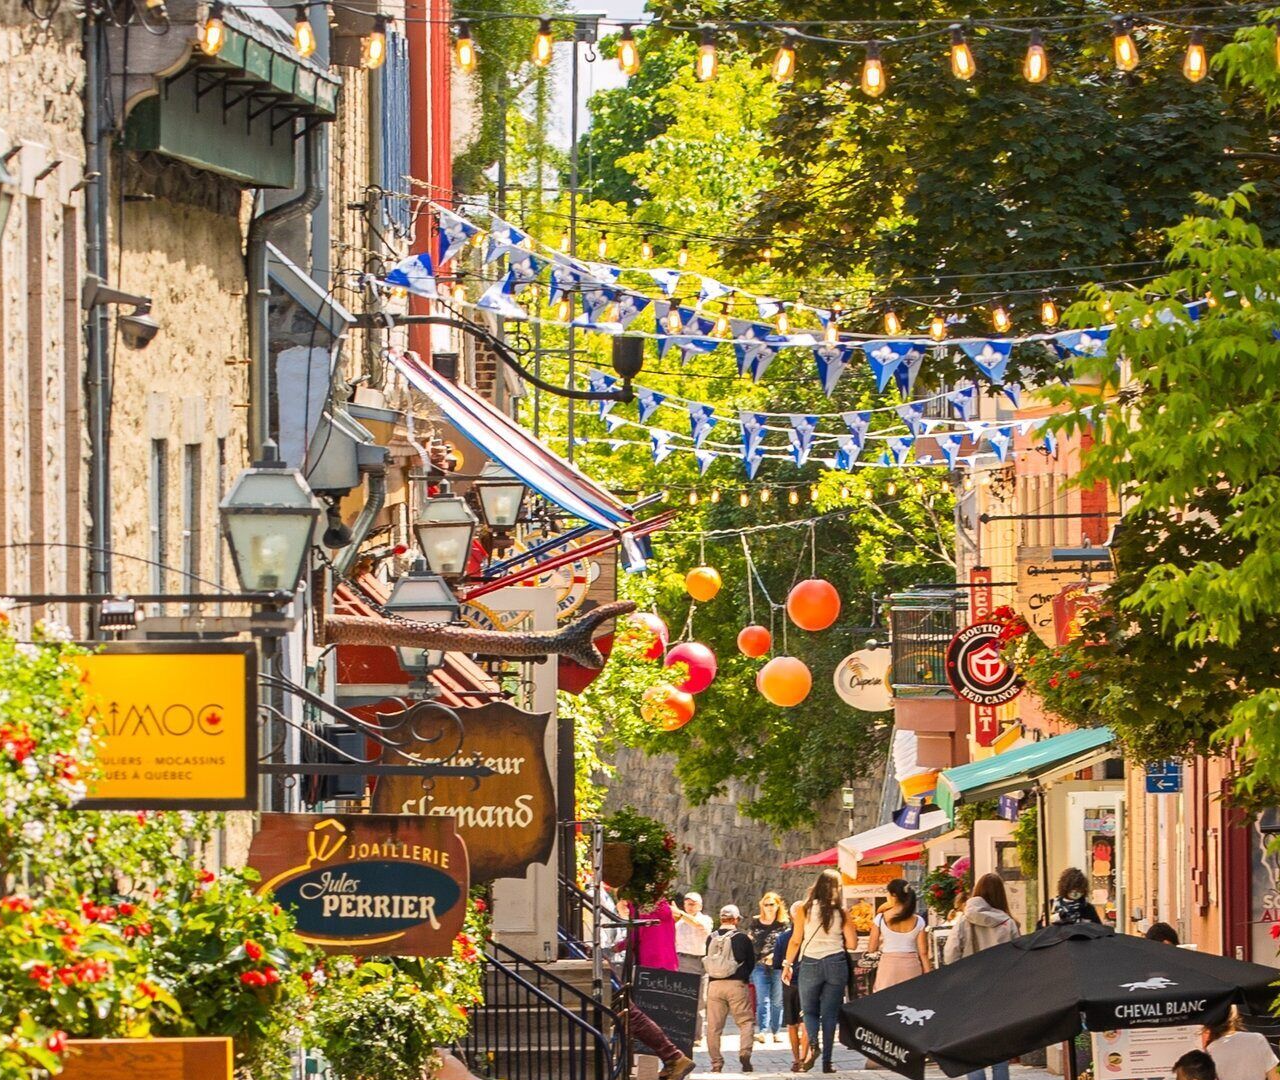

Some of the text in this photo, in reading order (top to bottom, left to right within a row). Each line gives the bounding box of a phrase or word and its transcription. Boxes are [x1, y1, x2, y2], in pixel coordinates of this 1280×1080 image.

[958, 623, 1006, 644] BOUTIQ
[959, 684, 1021, 706] RED CANOE
[99, 756, 226, 766] ULIERS MOCASSINS
[348, 843, 450, 869] JOAILLERIE
[299, 871, 361, 900] Jules
[322, 894, 442, 930] PERRIER
[1114, 999, 1207, 1018] CHEVAL BLANC
[854, 1026, 884, 1051] CHEVAL
[884, 1040, 910, 1064] BLANC
